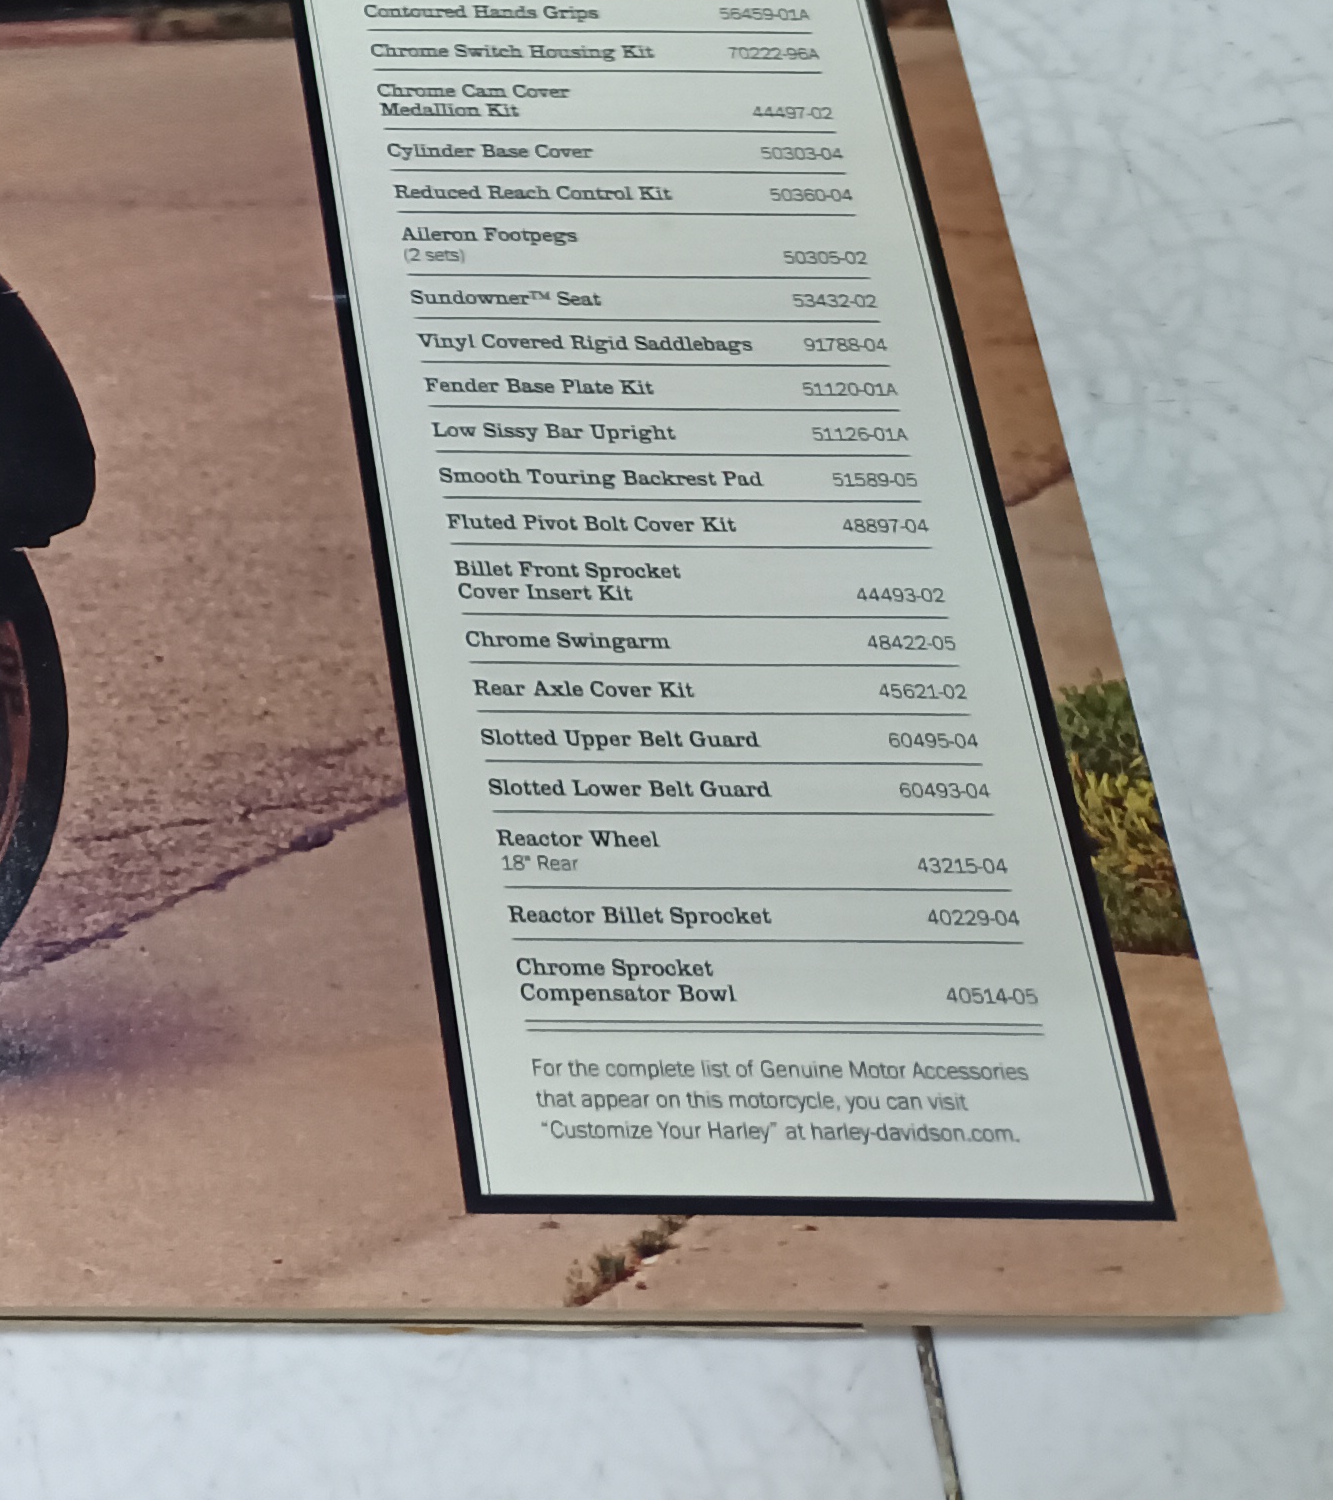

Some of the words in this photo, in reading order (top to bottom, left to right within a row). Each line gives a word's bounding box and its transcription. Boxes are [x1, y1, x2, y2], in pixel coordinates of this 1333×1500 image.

[364, 4, 468, 18] Contoured
[474, 5, 538, 19] Hands
[543, 6, 599, 23] Grips
[371, 44, 449, 57] Chrome
[454, 44, 524, 58] Switch
[528, 45, 616, 62] Housing
[621, 45, 655, 58] Kit
[377, 84, 456, 97] Chrome
[462, 84, 508, 98] Cam
[512, 84, 570, 98] Cover
[380, 103, 481, 117] Medallion
[486, 103, 519, 117] Kit
[753, 106, 832, 119] 44497-02
[387, 143, 476, 161] Cylinder
[480, 144, 530, 158] Base
[535, 144, 593, 158] Cover
[761, 147, 844, 160] 50303-04
[393, 185, 482, 199] Reduced
[487, 185, 551, 200] Reach
[556, 186, 634, 200] Control
[638, 186, 673, 200] Kit
[770, 188, 853, 202] 50360-04
[402, 227, 478, 241] Aileron
[483, 227, 577, 246] Footpegs
[404, 248, 421, 263] (2
[425, 249, 465, 263] sets)
[783, 251, 867, 265] 50305-02
[557, 291, 601, 306] Seat
[793, 294, 878, 308] 53432-02
[417, 333, 476, 352] Vinyl
[482, 334, 565, 349] Covered
[569, 335, 629, 354] Rigid
[634, 336, 753, 355] Saddlebags
[804, 338, 888, 352] 91788-04
[425, 377, 499, 393] Fender
[505, 378, 555, 393] Base
[560, 379, 614, 394] Plate
[619, 380, 654, 395] Kit
[802, 382, 898, 396] 51120-01A
[431, 422, 476, 437] Low
[483, 422, 538, 442] Sissy
[545, 423, 583, 439] Bar
[589, 424, 676, 444] Upright
[812, 427, 908, 441] 51126-01A
[439, 467, 521, 483] Smooth
[526, 469, 615, 489] Touring
[622, 470, 717, 486] Backrest
[721, 471, 764, 486] Pad
[833, 473, 917, 487] 51589-05
[446, 514, 517, 530] Fluted
[523, 514, 578, 531] Pivot
[584, 516, 628, 531] Bolt
[634, 516, 695, 532] Cover
[700, 517, 736, 532] Kit
[843, 518, 929, 533] 48897-04
[454, 560, 513, 577] Billet
[518, 561, 579, 578] Front
[585, 562, 681, 582] Sprocket
[458, 583, 519, 599] Cover
[525, 584, 592, 600] Insert
[597, 585, 633, 601] Kit
[857, 588, 945, 603] 44493-02
[466, 631, 550, 648] Chrome
[557, 632, 670, 653] Swingarm
[868, 635, 955, 651] 48422-05
[473, 680, 525, 696] Rear
[534, 680, 583, 697] Axle
[590, 681, 652, 697] Cover
[658, 682, 694, 698] Kit
[879, 684, 967, 699] 45621-02
[481, 728, 557, 746] Slotted
[564, 730, 631, 751] Upper
[638, 730, 683, 747] Belt
[690, 731, 760, 747] Guard
[889, 732, 978, 749] 60495-04
[488, 778, 566, 796] Slotted
[572, 779, 641, 797] Lower
[648, 780, 694, 797] Belt
[700, 780, 772, 797] Guard
[900, 782, 990, 799] 60493-04
[497, 829, 583, 847] Reactor
[589, 830, 659, 847] Wheel
[502, 855, 531, 871] 18"
[537, 855, 578, 871] Rear
[918, 857, 1008, 874] 43215-04
[508, 905, 595, 923] Reactor
[602, 906, 663, 924] Billet
[670, 907, 771, 929] Sprocket
[928, 909, 1020, 926] 40229-04
[516, 958, 605, 976] Chrome
[612, 958, 713, 981] Sprocket
[521, 983, 671, 1006] Compensator
[677, 984, 736, 1002] Bowl
[947, 987, 1038, 1005] 40514-05
[532, 1058, 562, 1077] For
[568, 1059, 599, 1077] the
[606, 1060, 695, 1080] complete
[701, 1060, 731, 1078] list
[736, 1059, 753, 1078] of
[761, 1060, 843, 1078] Genuine
[849, 1061, 905, 1079] Motor
[913, 1061, 1029, 1081] Accessories
[536, 1090, 576, 1108] that
[581, 1094, 650, 1111] appear
[656, 1094, 680, 1108] on
[686, 1091, 723, 1109] this
[729, 1091, 840, 1113] motorcycle,
[845, 1096, 880, 1114] you
[887, 1096, 923, 1110] can
[927, 1094, 968, 1111] visit
[657, 1121, 701, 1139] Your
[785, 1123, 806, 1140] at
[811, 1122, 1020, 1145] harley-davidson.com.
